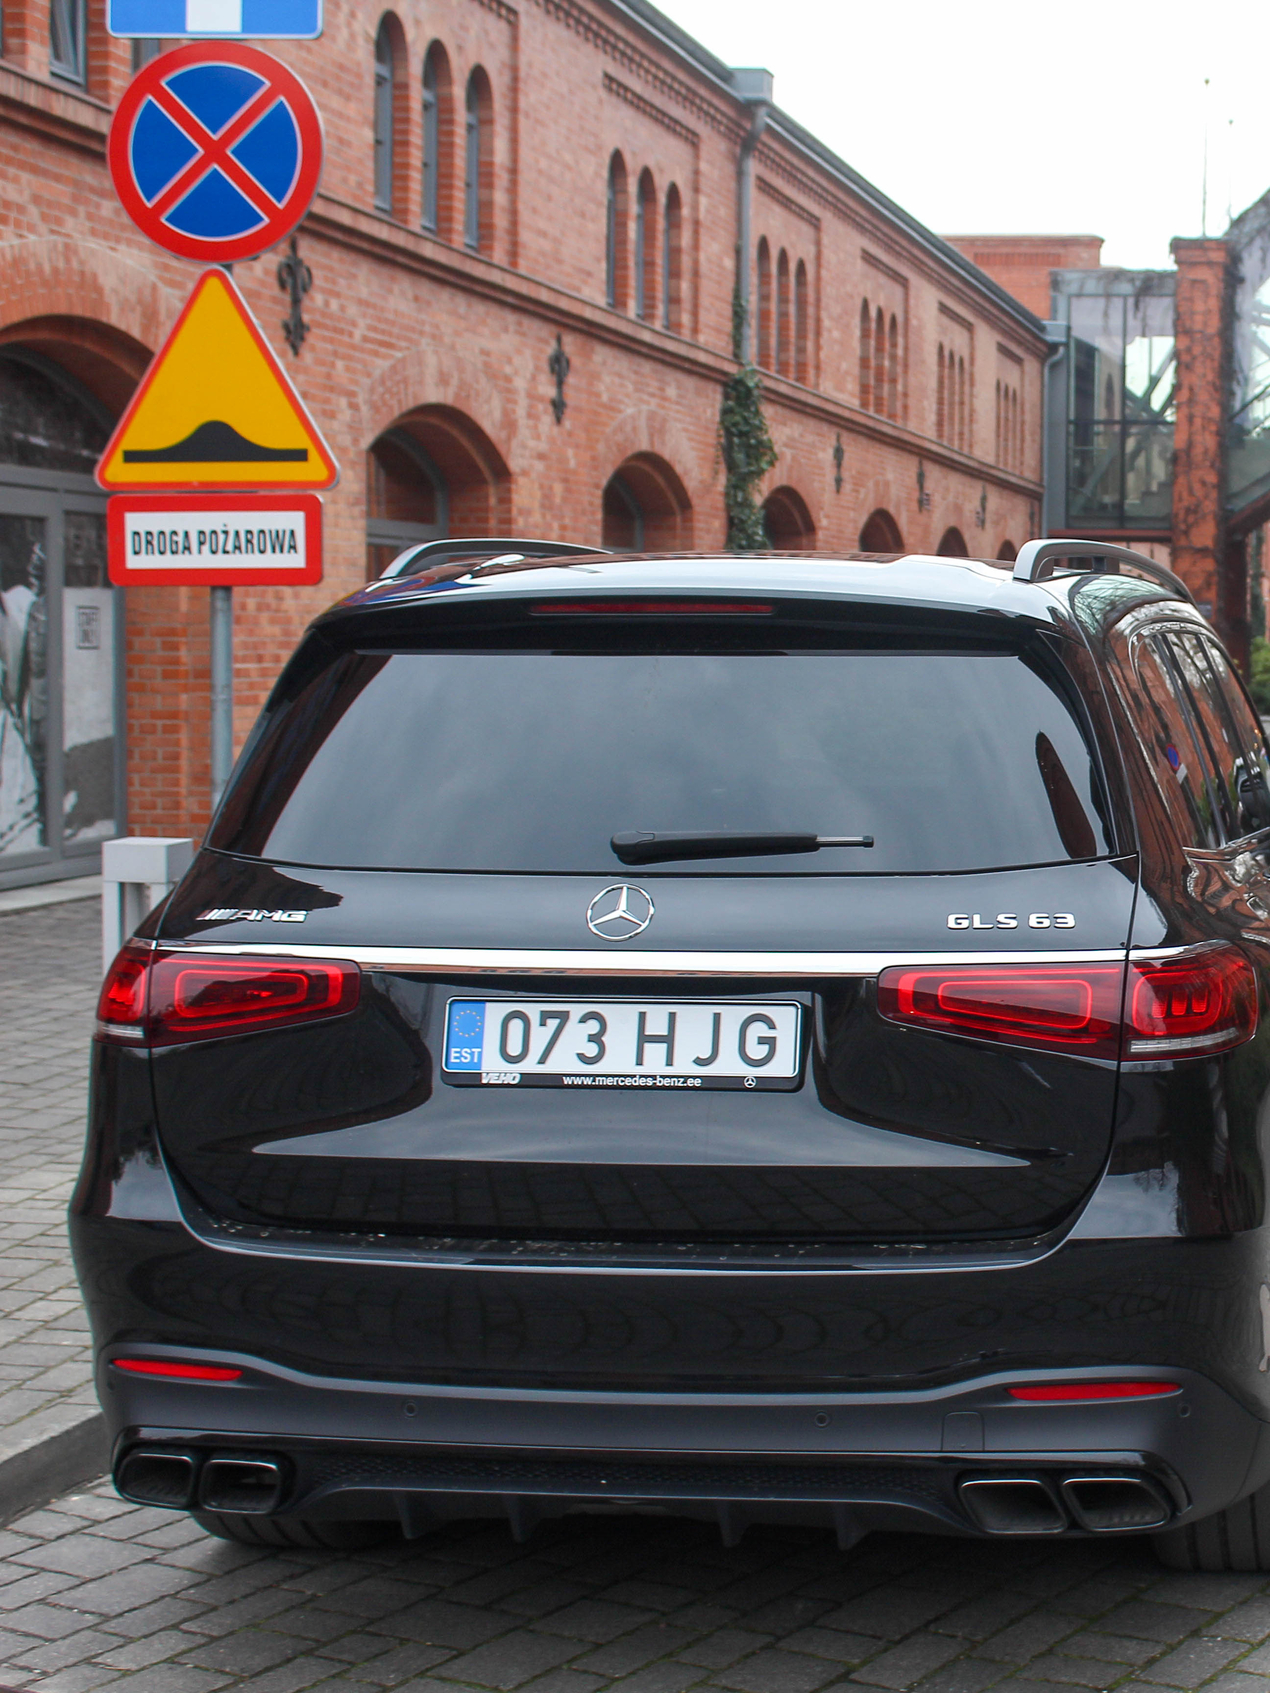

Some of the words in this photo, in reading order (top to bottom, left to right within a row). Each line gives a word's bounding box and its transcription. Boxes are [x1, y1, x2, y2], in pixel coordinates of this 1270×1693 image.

[132, 530, 192, 555] DROGA
[197, 523, 298, 554] POŻAROWA
[226, 909, 308, 923] AMG
[947, 913, 1018, 929] GLS
[1028, 913, 1076, 929] 63
[499, 1009, 608, 1065] 073
[635, 1010, 778, 1068] HJG
[450, 1047, 482, 1063] EST
[480, 1072, 521, 1085] VEHO
[562, 1074, 702, 1088] www.mercedes-benz.ee
